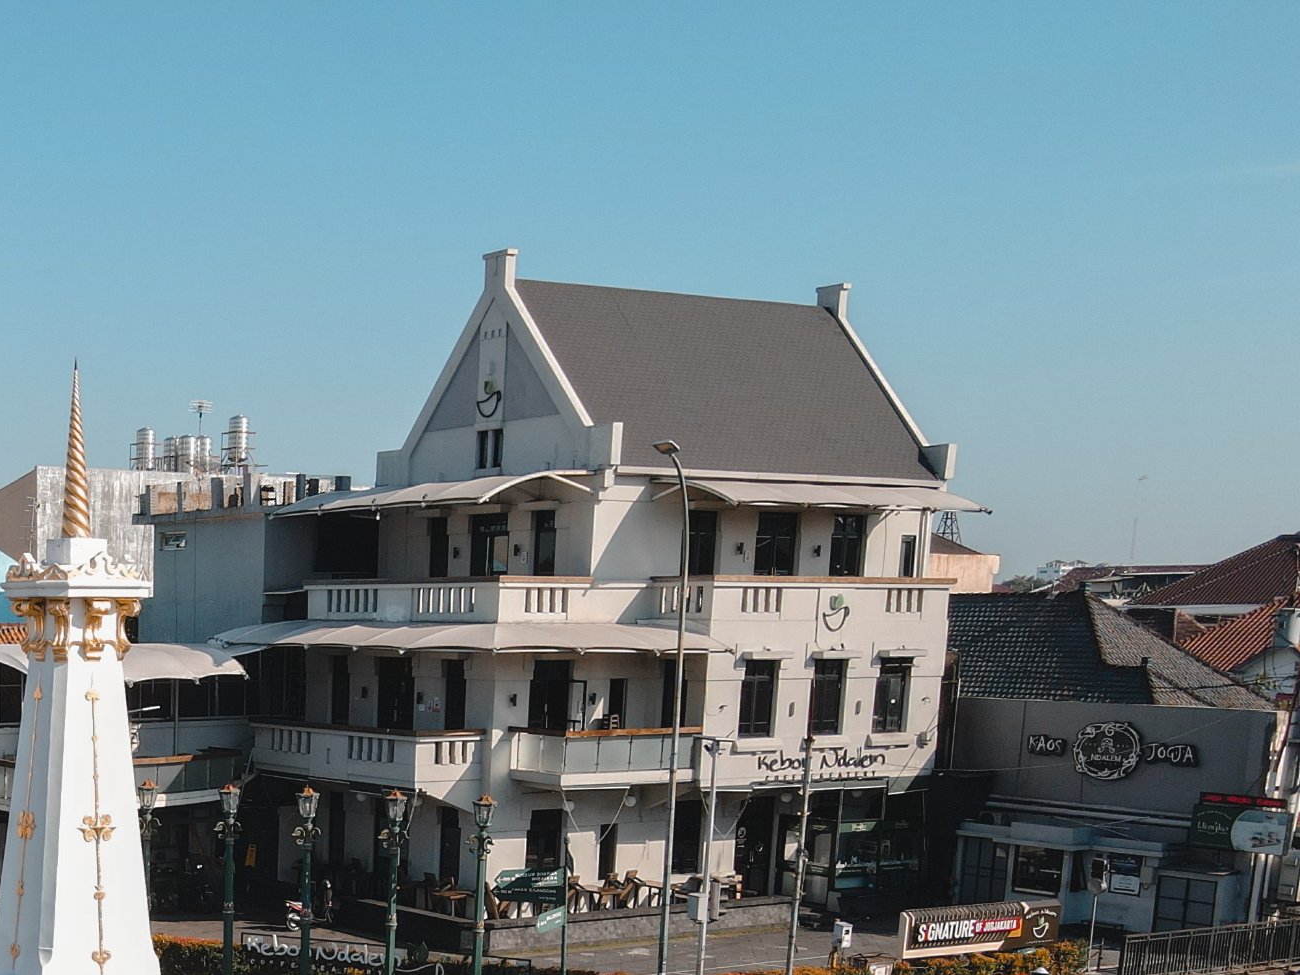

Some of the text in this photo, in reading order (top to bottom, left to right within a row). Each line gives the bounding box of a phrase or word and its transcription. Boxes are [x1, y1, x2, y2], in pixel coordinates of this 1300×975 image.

[1028, 736, 1194, 763] KAOS JOGJA
[1090, 753, 1122, 763] NDALEM
[757, 747, 886, 772] Kebo Ndalem
[975, 922, 984, 932] OF
